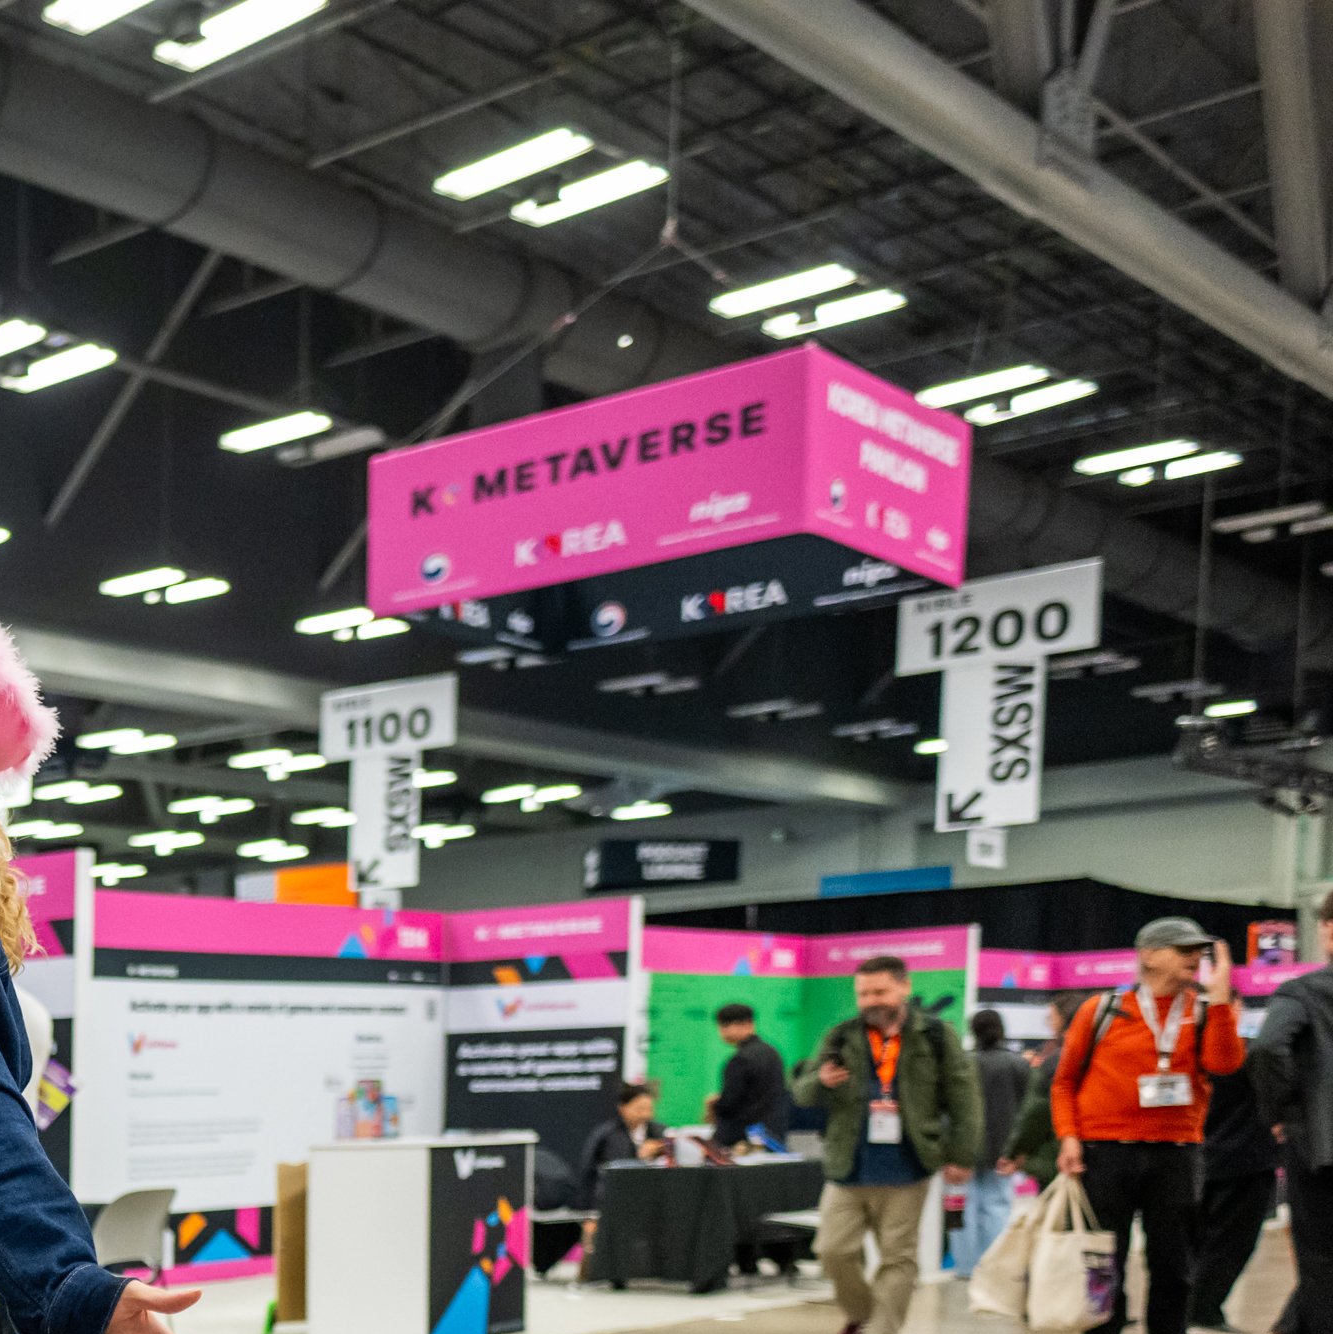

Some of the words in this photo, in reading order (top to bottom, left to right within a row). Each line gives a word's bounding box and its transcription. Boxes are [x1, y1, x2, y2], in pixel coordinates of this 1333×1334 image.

[410, 487, 437, 518] K
[472, 402, 766, 504] METAVERSE
[927, 601, 1071, 657] 1200
[347, 707, 432, 747] 1100
[990, 665, 1035, 783] SXSW
[386, 756, 412, 853] SXSW
